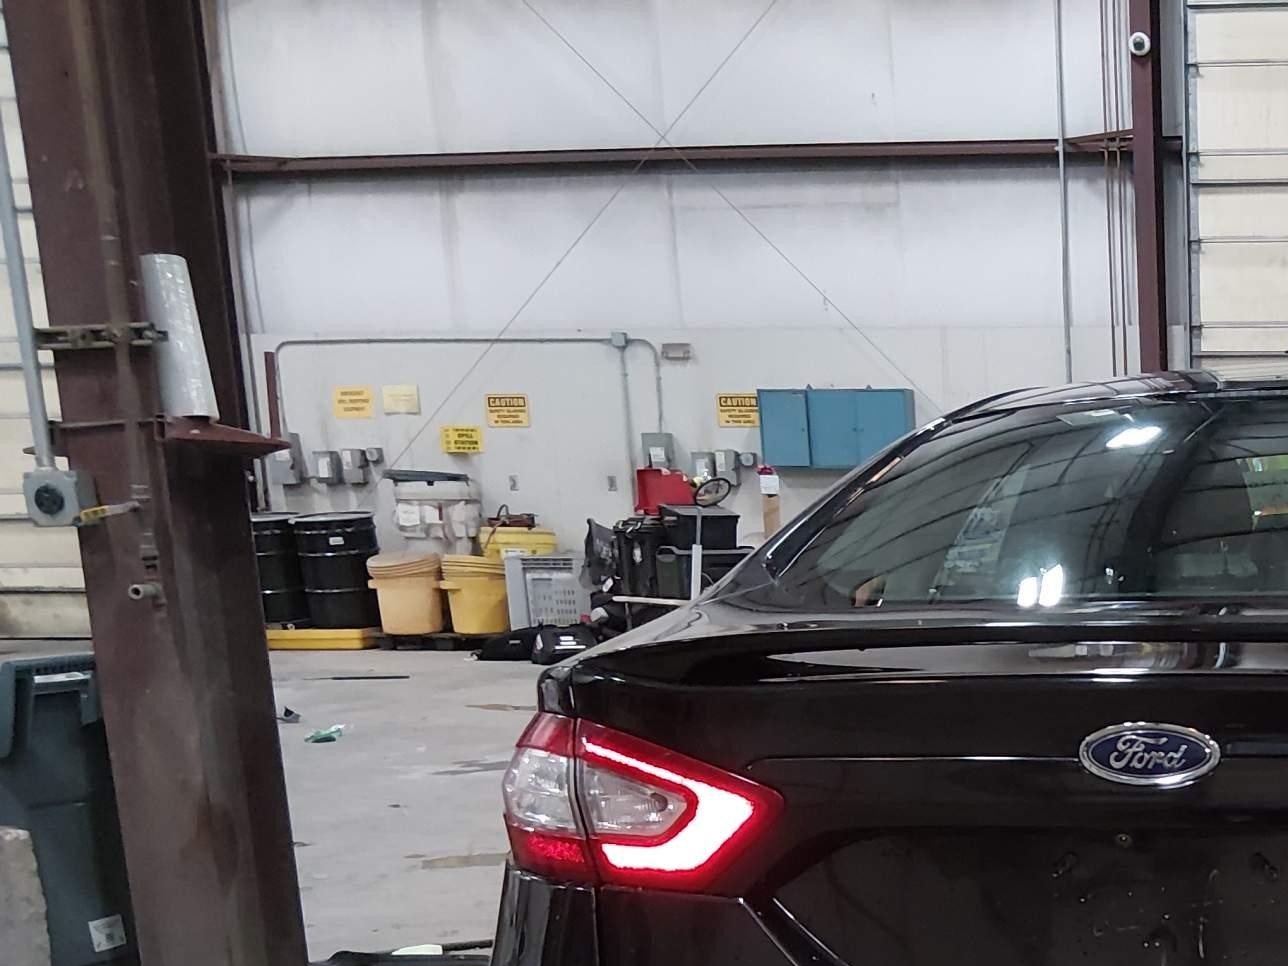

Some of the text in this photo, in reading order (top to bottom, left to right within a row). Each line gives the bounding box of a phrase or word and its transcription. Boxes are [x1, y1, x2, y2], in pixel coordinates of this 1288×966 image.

[489, 397, 525, 407] CAUTION
[720, 397, 757, 407] CAUTION
[1109, 735, 1188, 769] Ford
